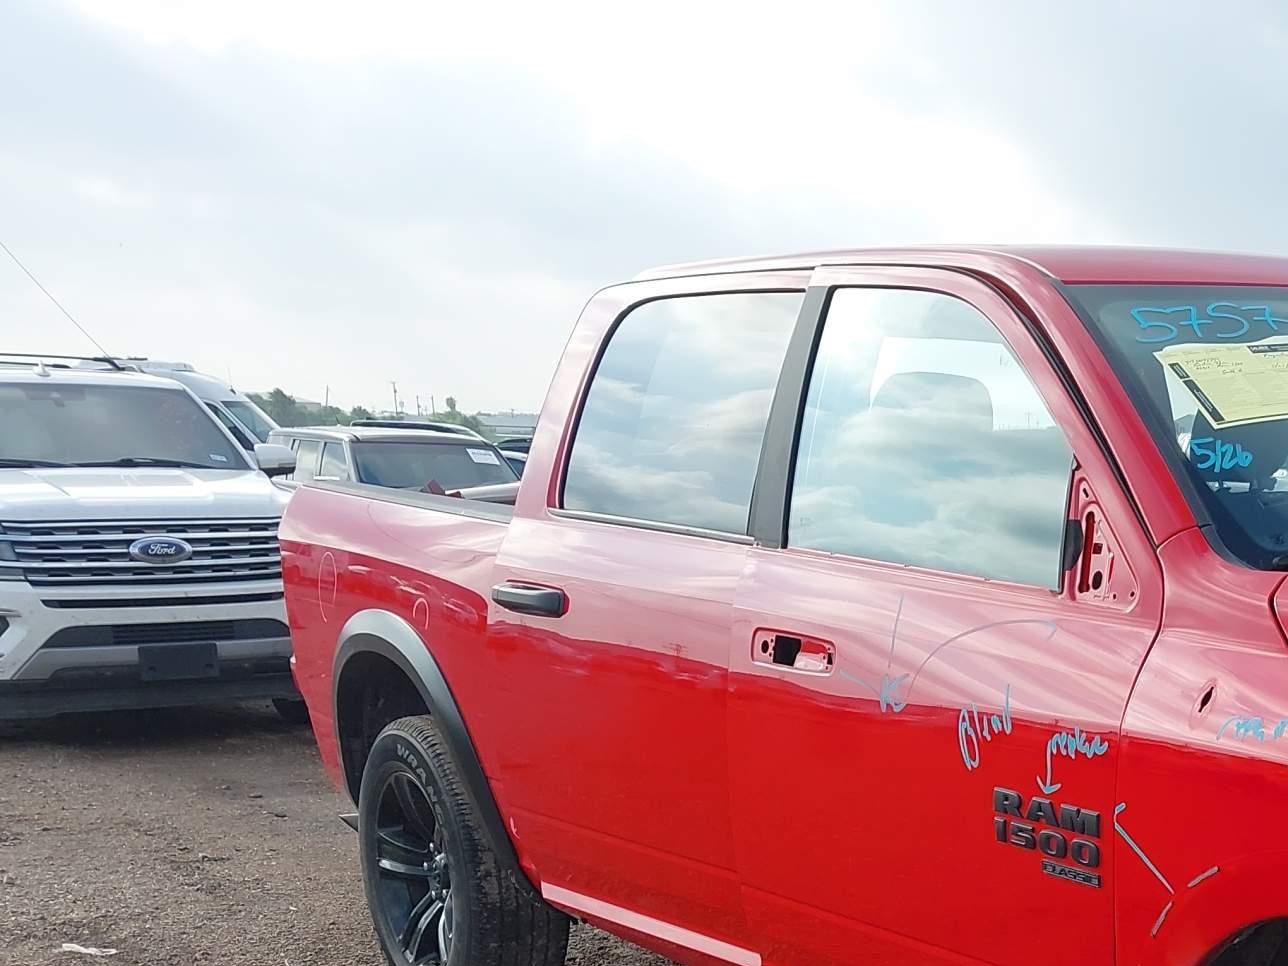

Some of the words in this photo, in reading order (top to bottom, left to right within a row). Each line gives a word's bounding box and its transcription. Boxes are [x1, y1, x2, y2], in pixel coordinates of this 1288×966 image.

[148, 543, 177, 555] Ford
[993, 786, 1101, 838] RAM
[994, 816, 1100, 868] 1500
